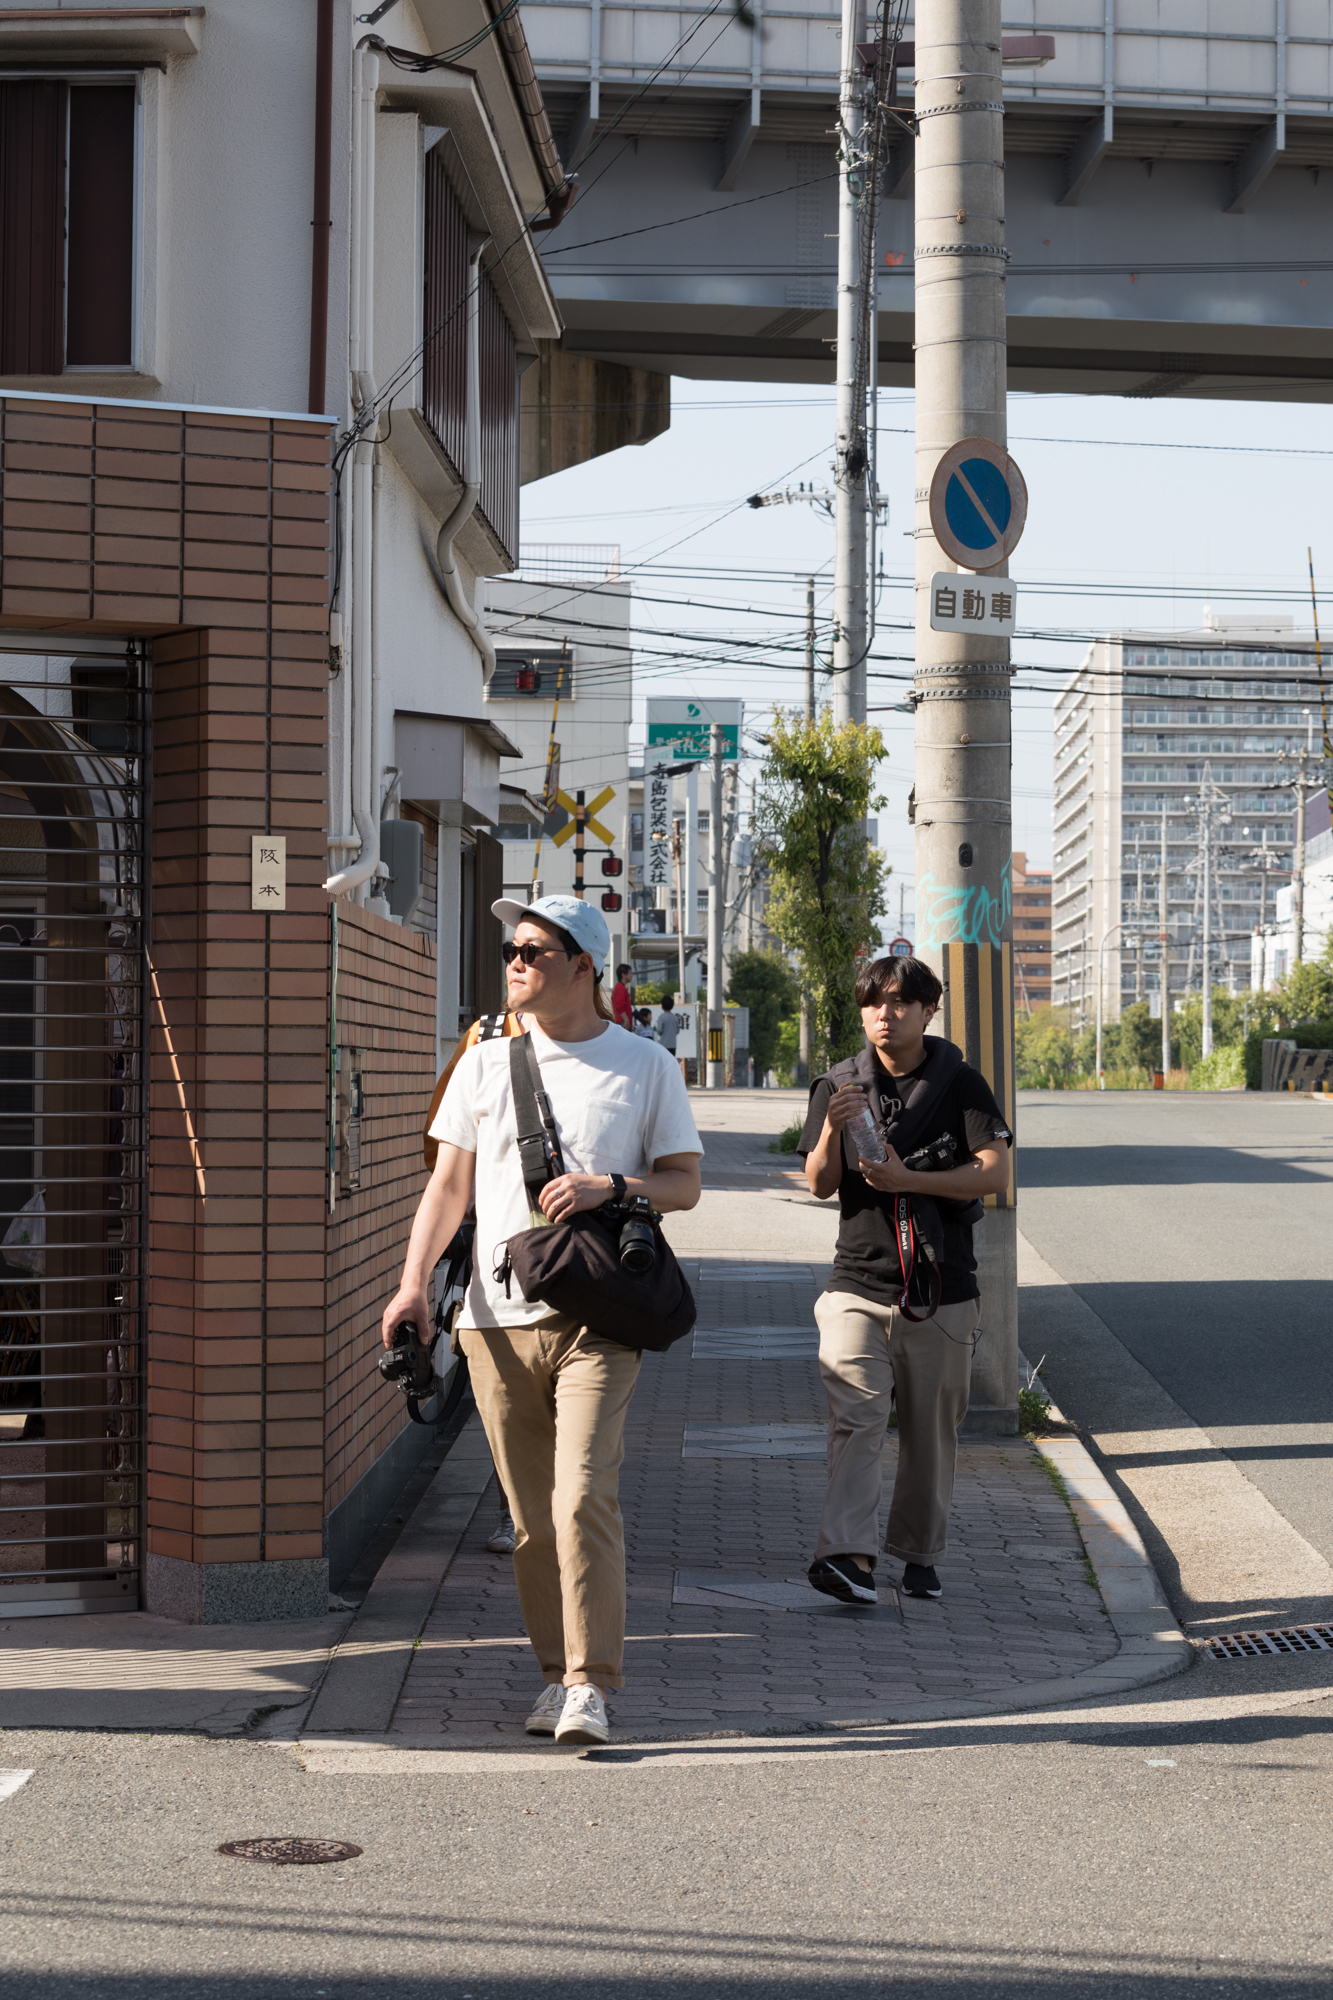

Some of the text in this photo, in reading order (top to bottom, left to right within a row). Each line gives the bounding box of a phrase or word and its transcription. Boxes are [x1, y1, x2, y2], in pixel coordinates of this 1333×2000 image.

[935, 586, 1012, 623] 自動車
[259, 848, 280, 896] 阪本
[899, 1198, 907, 1219] EOS
[900, 1220, 908, 1232] 6D
